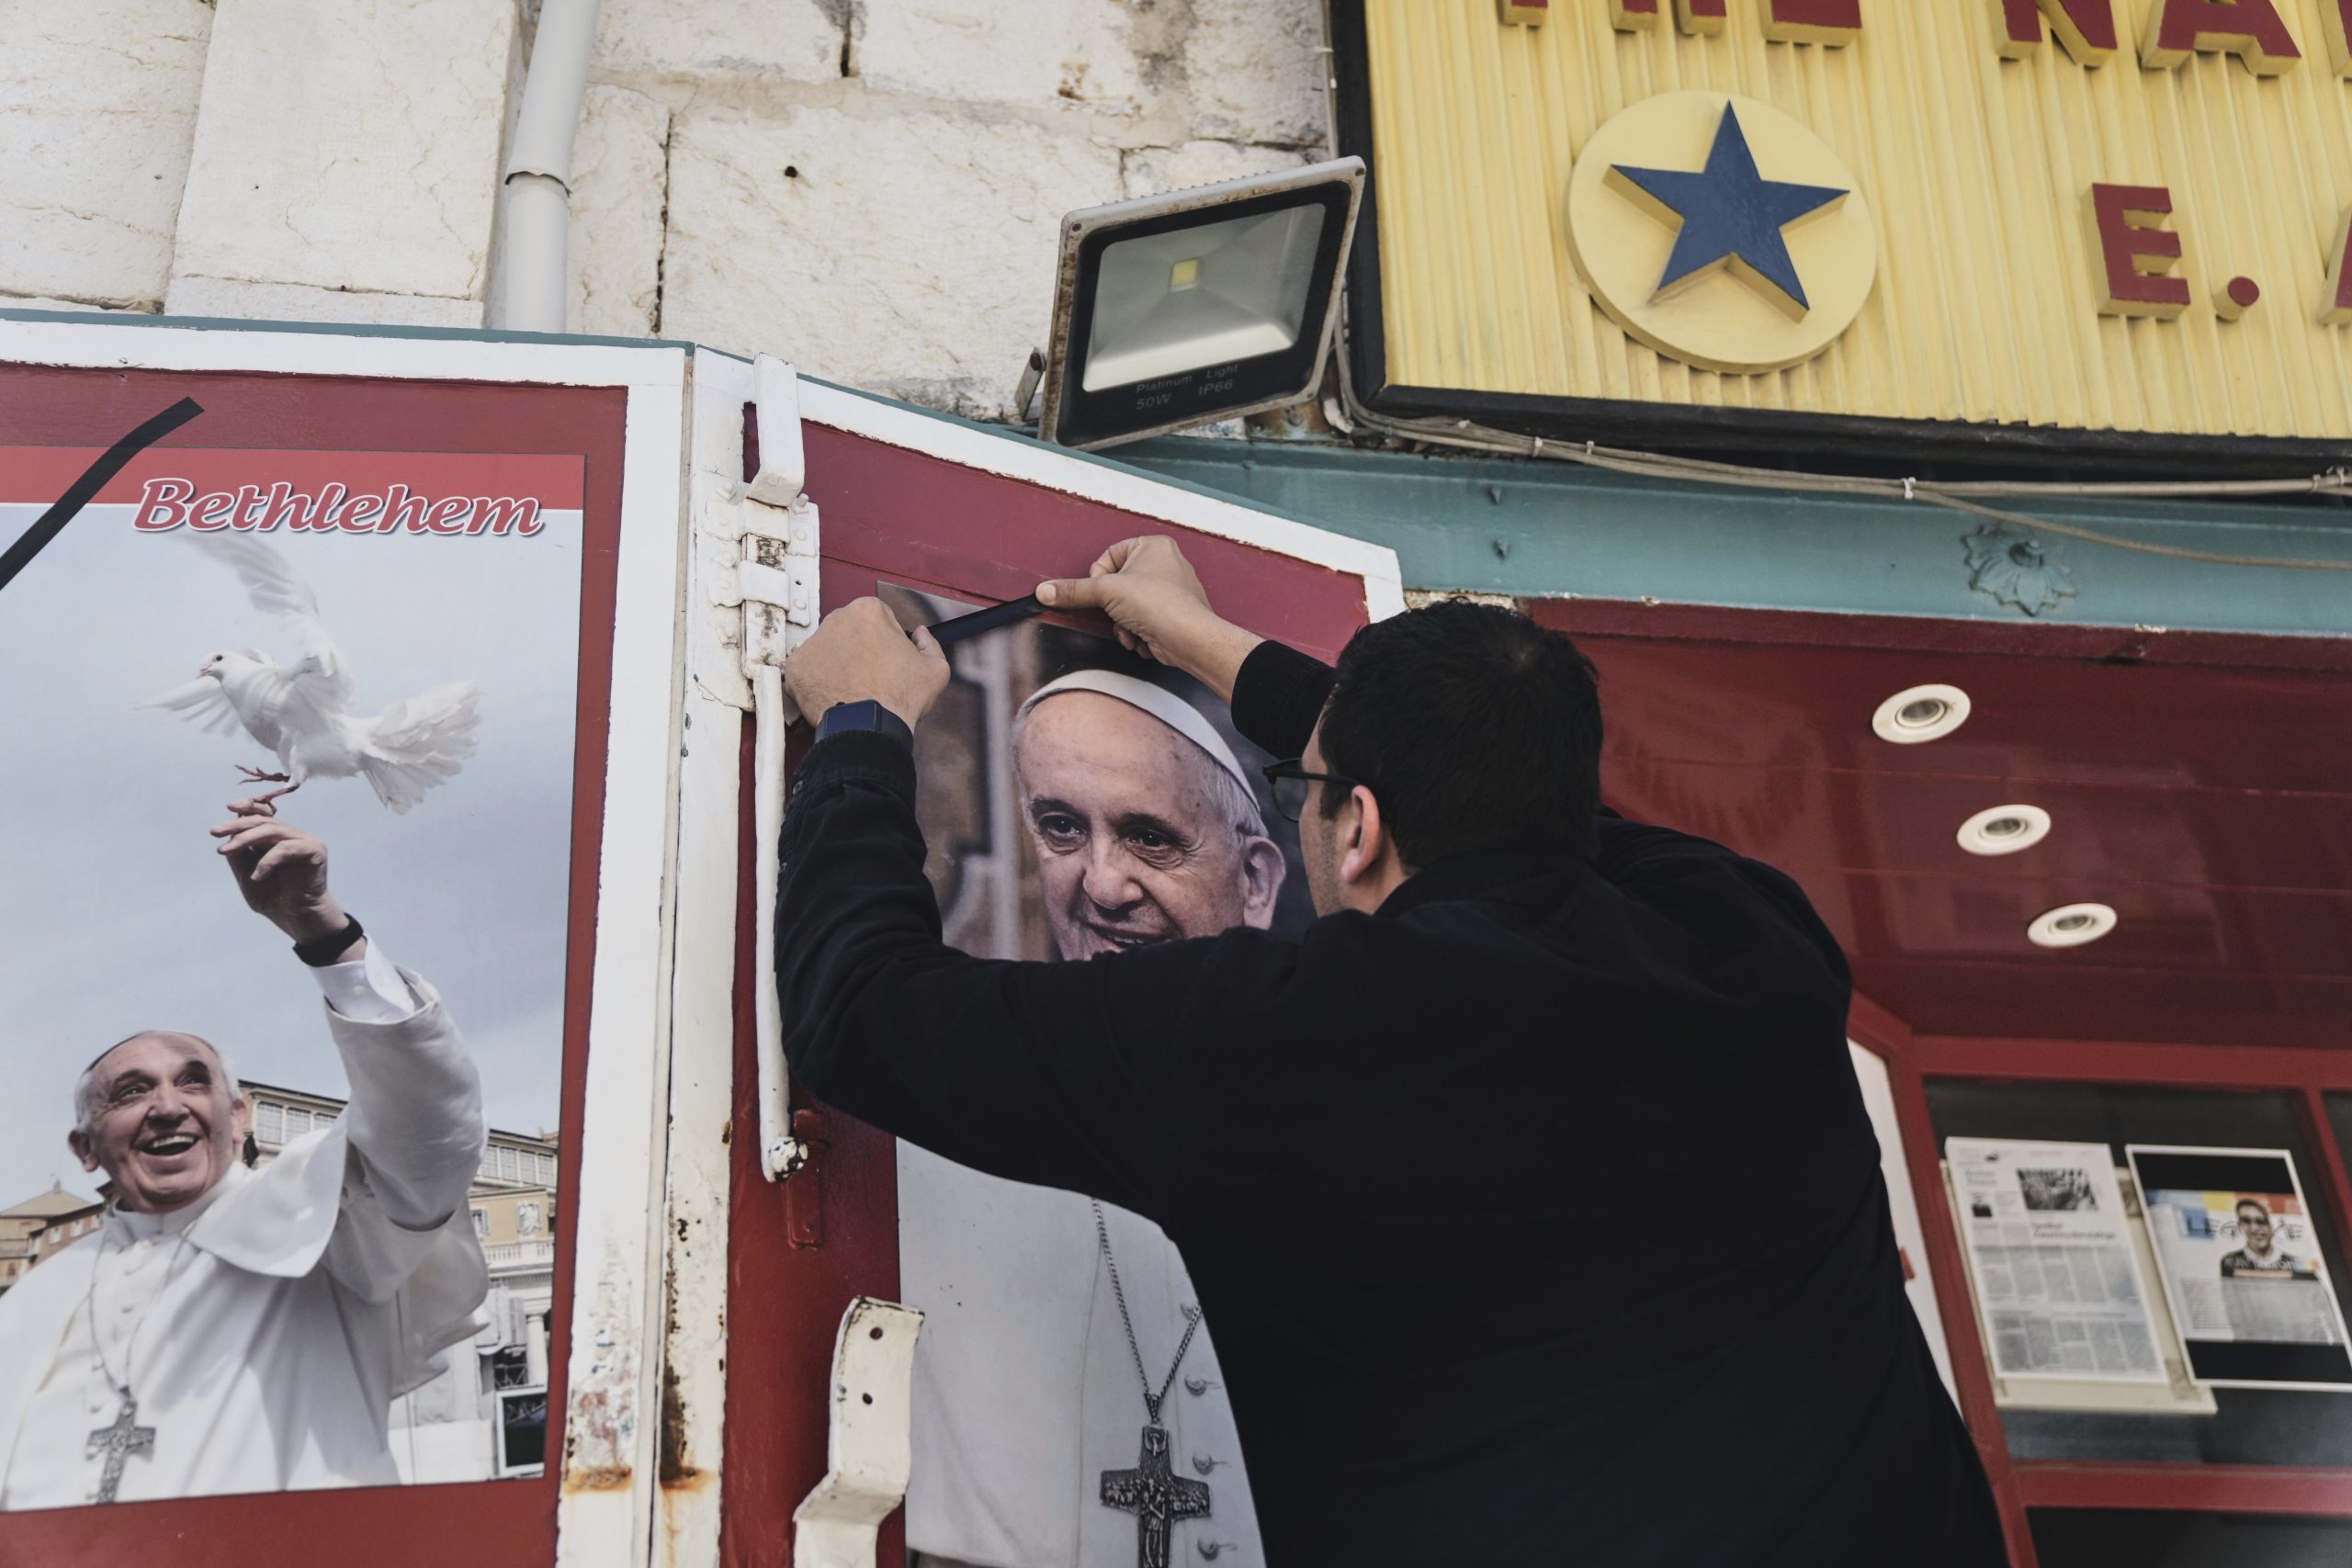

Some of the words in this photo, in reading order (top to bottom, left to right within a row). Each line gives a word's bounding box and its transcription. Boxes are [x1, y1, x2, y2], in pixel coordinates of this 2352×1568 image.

[1136, 375, 1193, 394] Platinum
[1205, 364, 1239, 379] Light
[1136, 392, 1173, 411] 50W
[1198, 378, 1234, 397] IP66
[132, 477, 544, 536] Bethlehem
